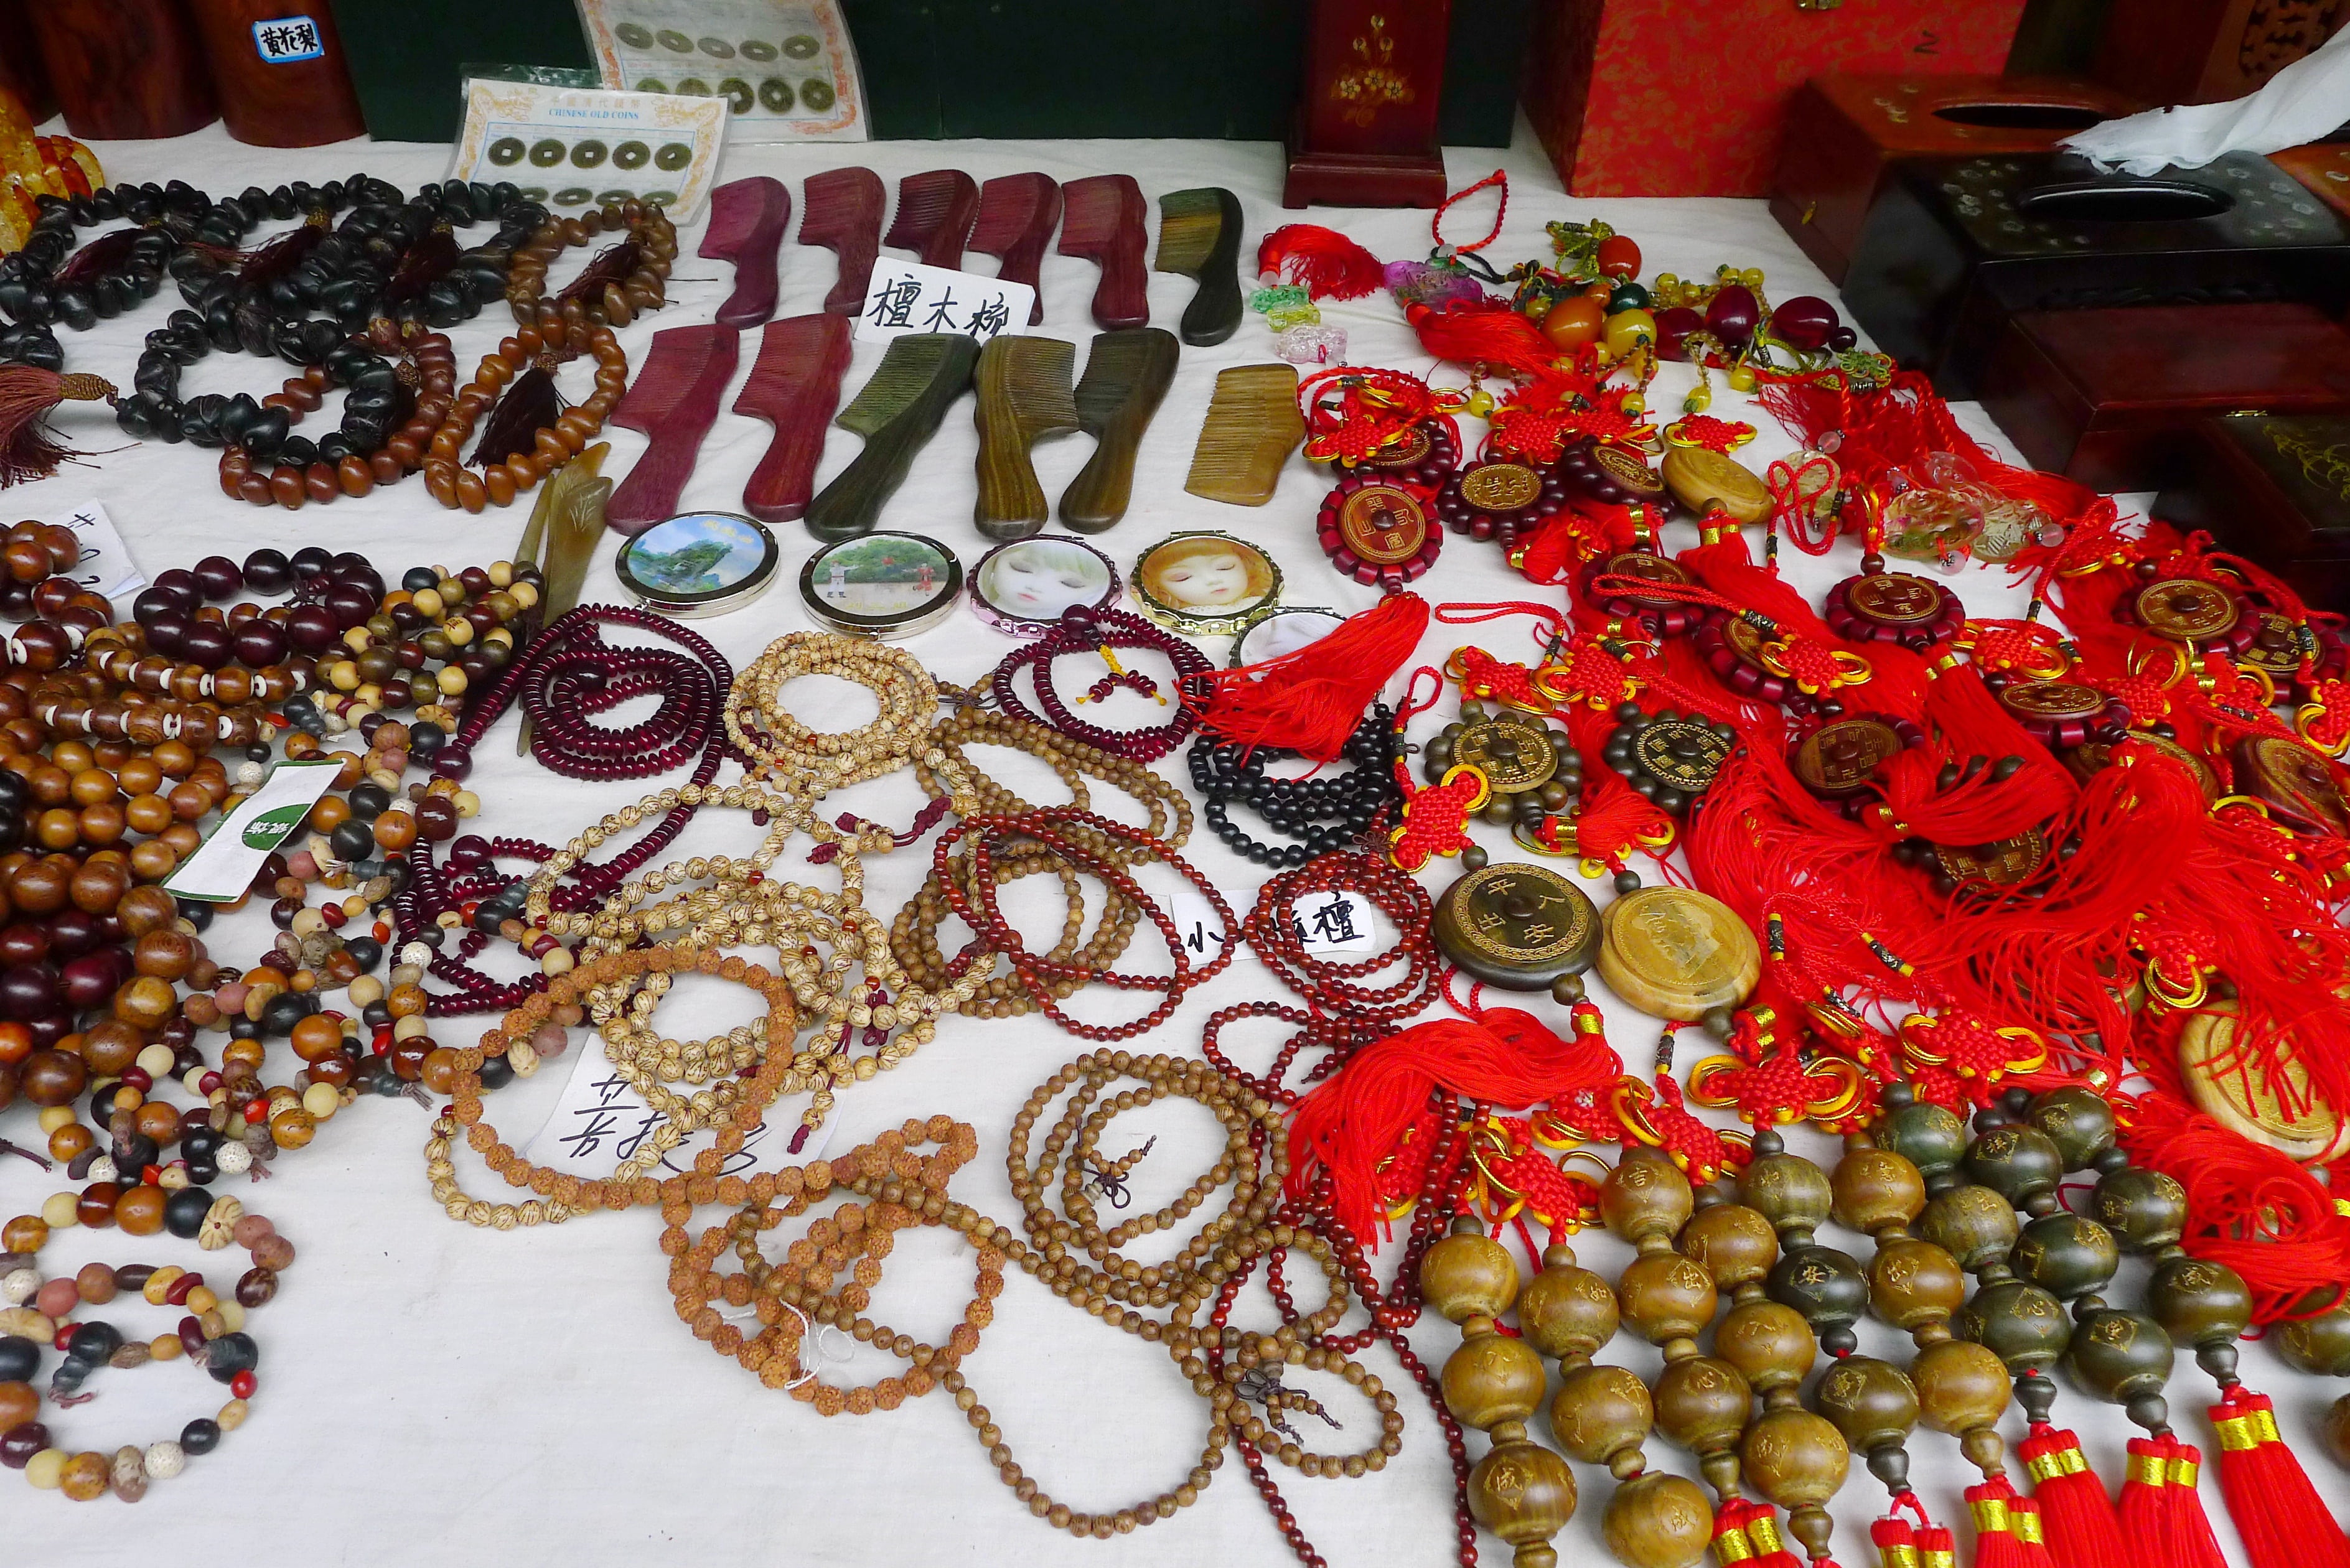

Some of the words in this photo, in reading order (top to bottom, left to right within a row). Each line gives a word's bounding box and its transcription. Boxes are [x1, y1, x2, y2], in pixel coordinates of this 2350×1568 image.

[549, 108, 588, 118] CHINESE
[590, 110, 609, 119] OLD
[611, 111, 639, 119] COINS
[866, 274, 1009, 337] 檀木梳
